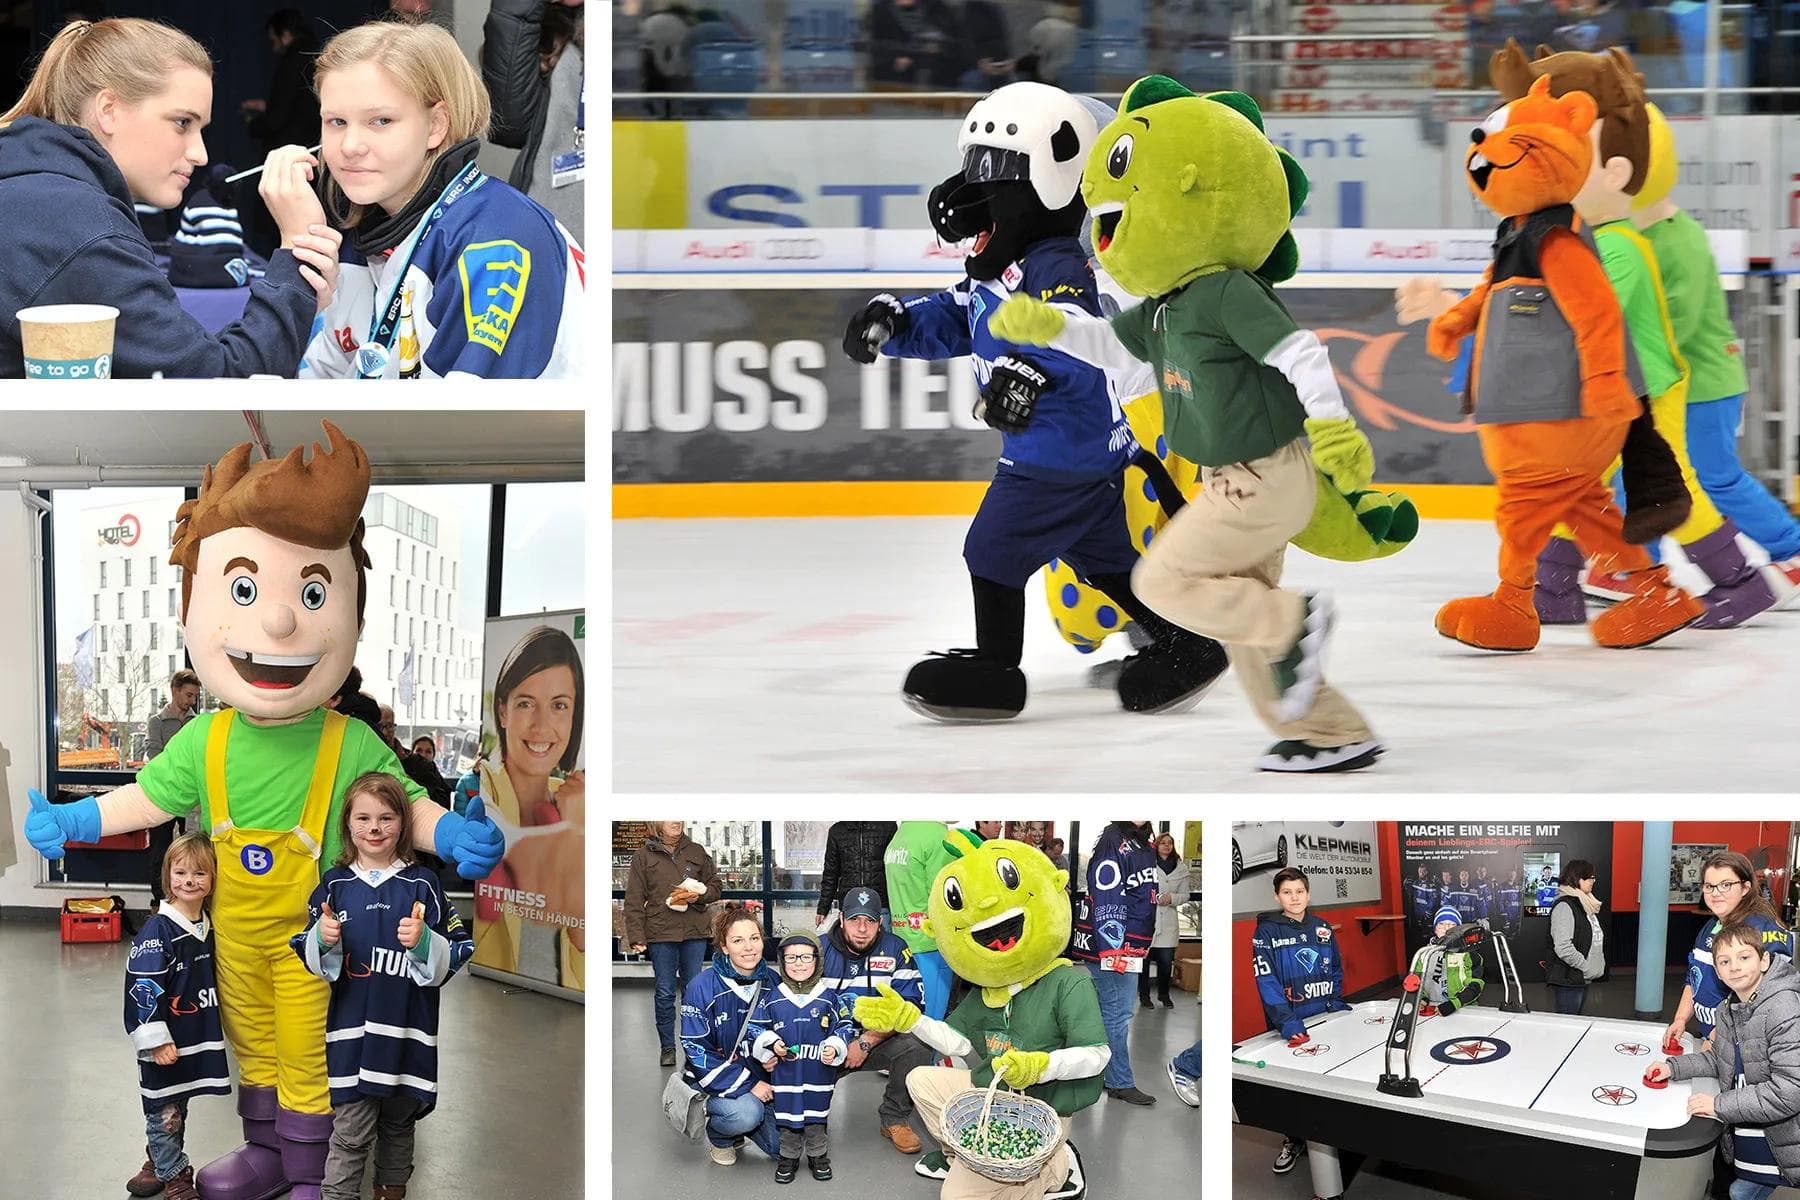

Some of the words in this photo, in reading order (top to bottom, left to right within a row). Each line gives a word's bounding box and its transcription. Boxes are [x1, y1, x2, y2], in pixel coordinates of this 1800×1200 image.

[444, 183, 464, 206] ERC
[463, 164, 482, 184] INGO
[682, 241, 754, 259] Audi
[1367, 240, 1438, 259] Audi
[47, 364, 65, 376] to
[69, 365, 89, 378] go
[98, 525, 134, 539] HOTEL
[1405, 825, 1455, 837] MACHE
[1459, 825, 1483, 837] EIN
[1487, 825, 1531, 837] SELFIE
[1536, 825, 1561, 837] MIT
[1295, 833, 1371, 855] KLEPMEIR
[1406, 838, 1436, 846] deinem
[248, 850, 268, 870] B
[1296, 851, 1308, 860] DIE
[1310, 853, 1326, 861] WELT
[1298, 865, 1328, 875] Telefon:
[480, 883, 546, 908] FITNESS
[494, 901, 505, 912] IN
[507, 905, 544, 920] BESTEN
